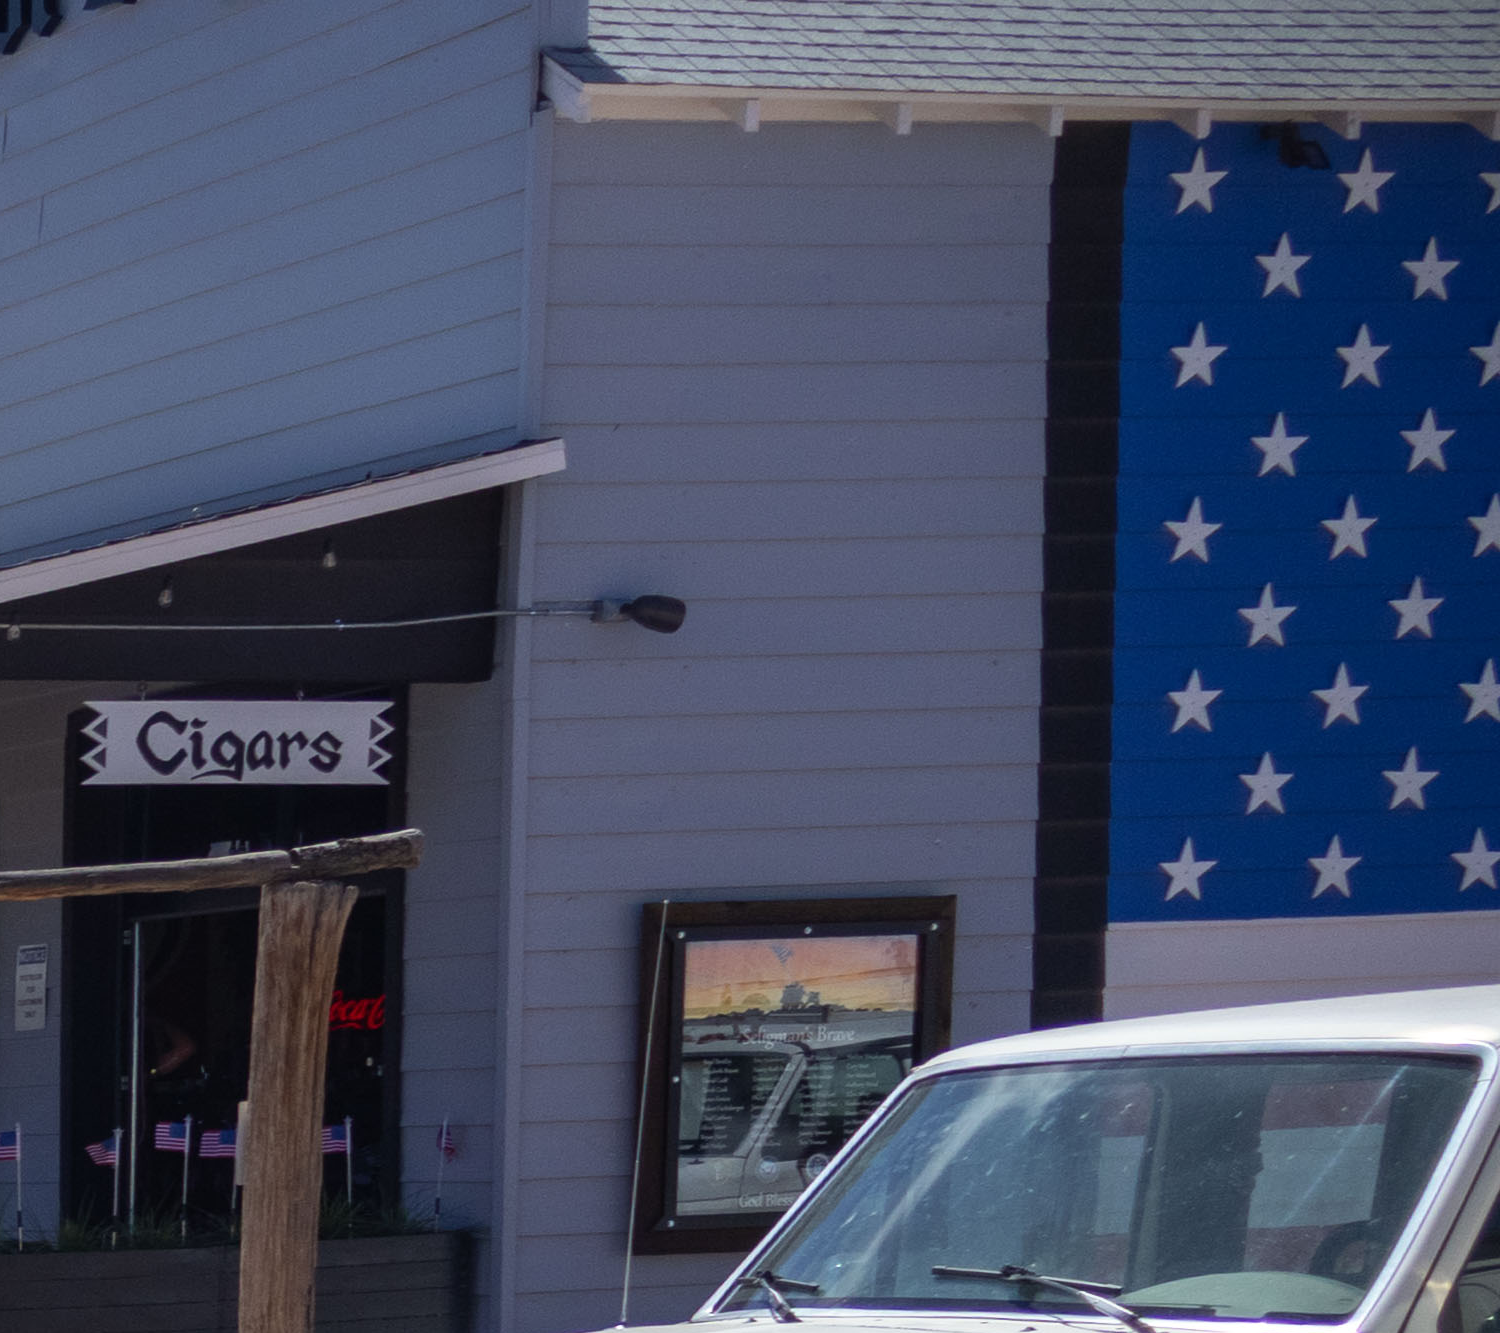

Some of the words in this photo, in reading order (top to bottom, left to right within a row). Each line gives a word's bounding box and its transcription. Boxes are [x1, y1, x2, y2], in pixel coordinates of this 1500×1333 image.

[136, 710, 344, 782] Cigars
[741, 1027, 814, 1049] Seligman's
[817, 1026, 855, 1042] Brave
